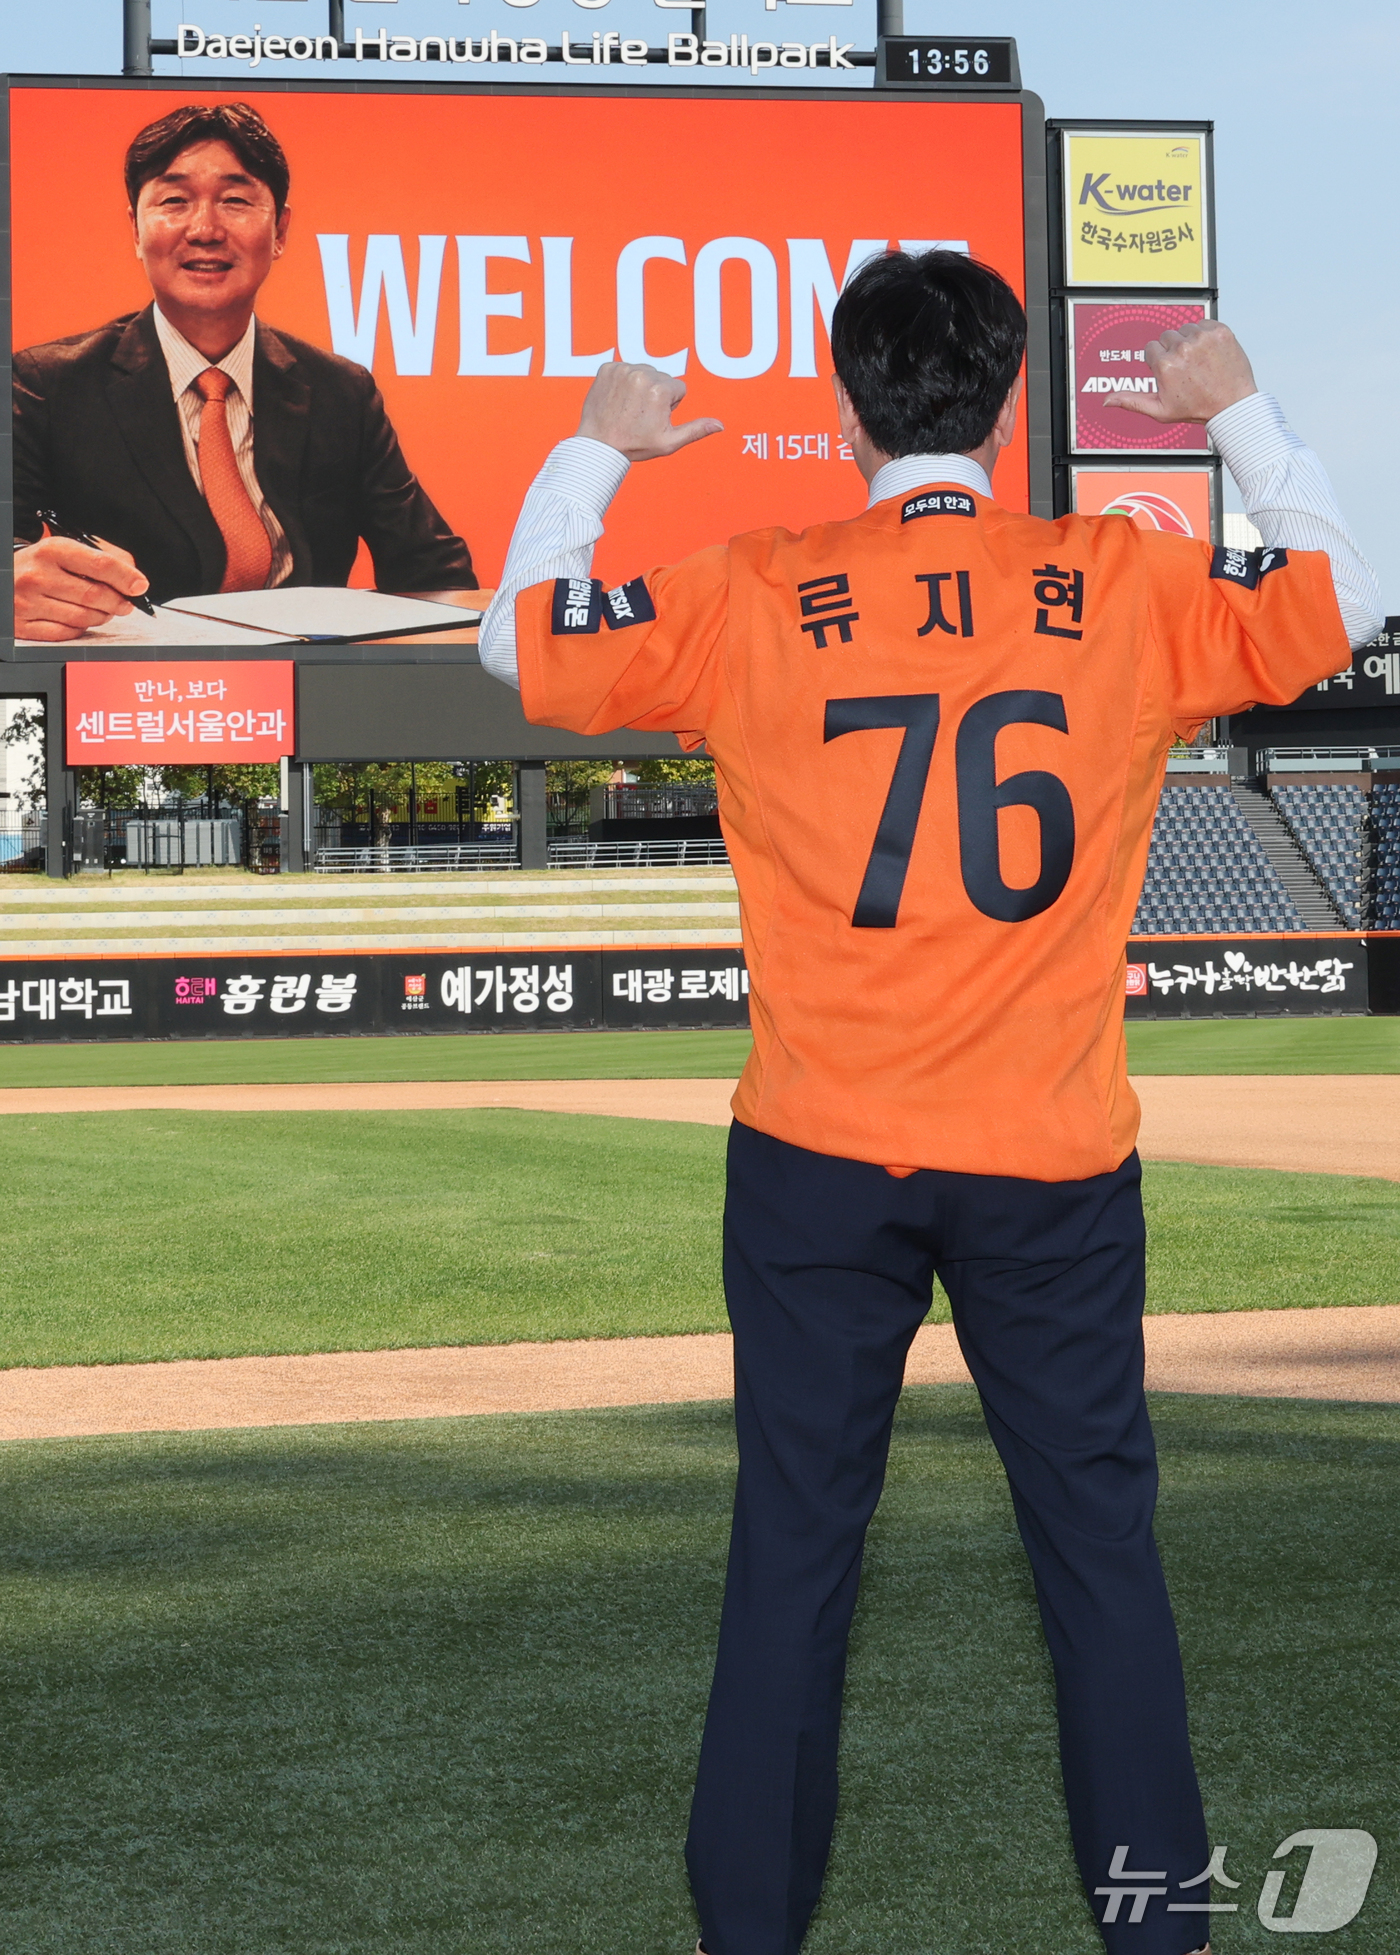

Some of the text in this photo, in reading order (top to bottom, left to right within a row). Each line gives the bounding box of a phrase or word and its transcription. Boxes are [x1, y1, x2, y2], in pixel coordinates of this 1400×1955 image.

[177, 24, 855, 75] Daejeon Hanwha Life Ballpark
[908, 48, 989, 75] 13:56
[1078, 172, 1193, 212] K-water
[1080, 220, 1195, 254] 한국수자원공사
[1099, 349, 1132, 362] 반도체
[741, 432, 769, 460] 제
[775, 432, 830, 460] 15대
[903, 496, 971, 517] 모두의 안과
[75, 708, 287, 743] 센트럴서울안과
[823, 689, 1076, 929] 76
[175, 996, 205, 1005] HAITAI
[219, 973, 358, 1015] 홈런볼
[440, 965, 574, 1014] 예가정성
[612, 968, 675, 1003] 대광
